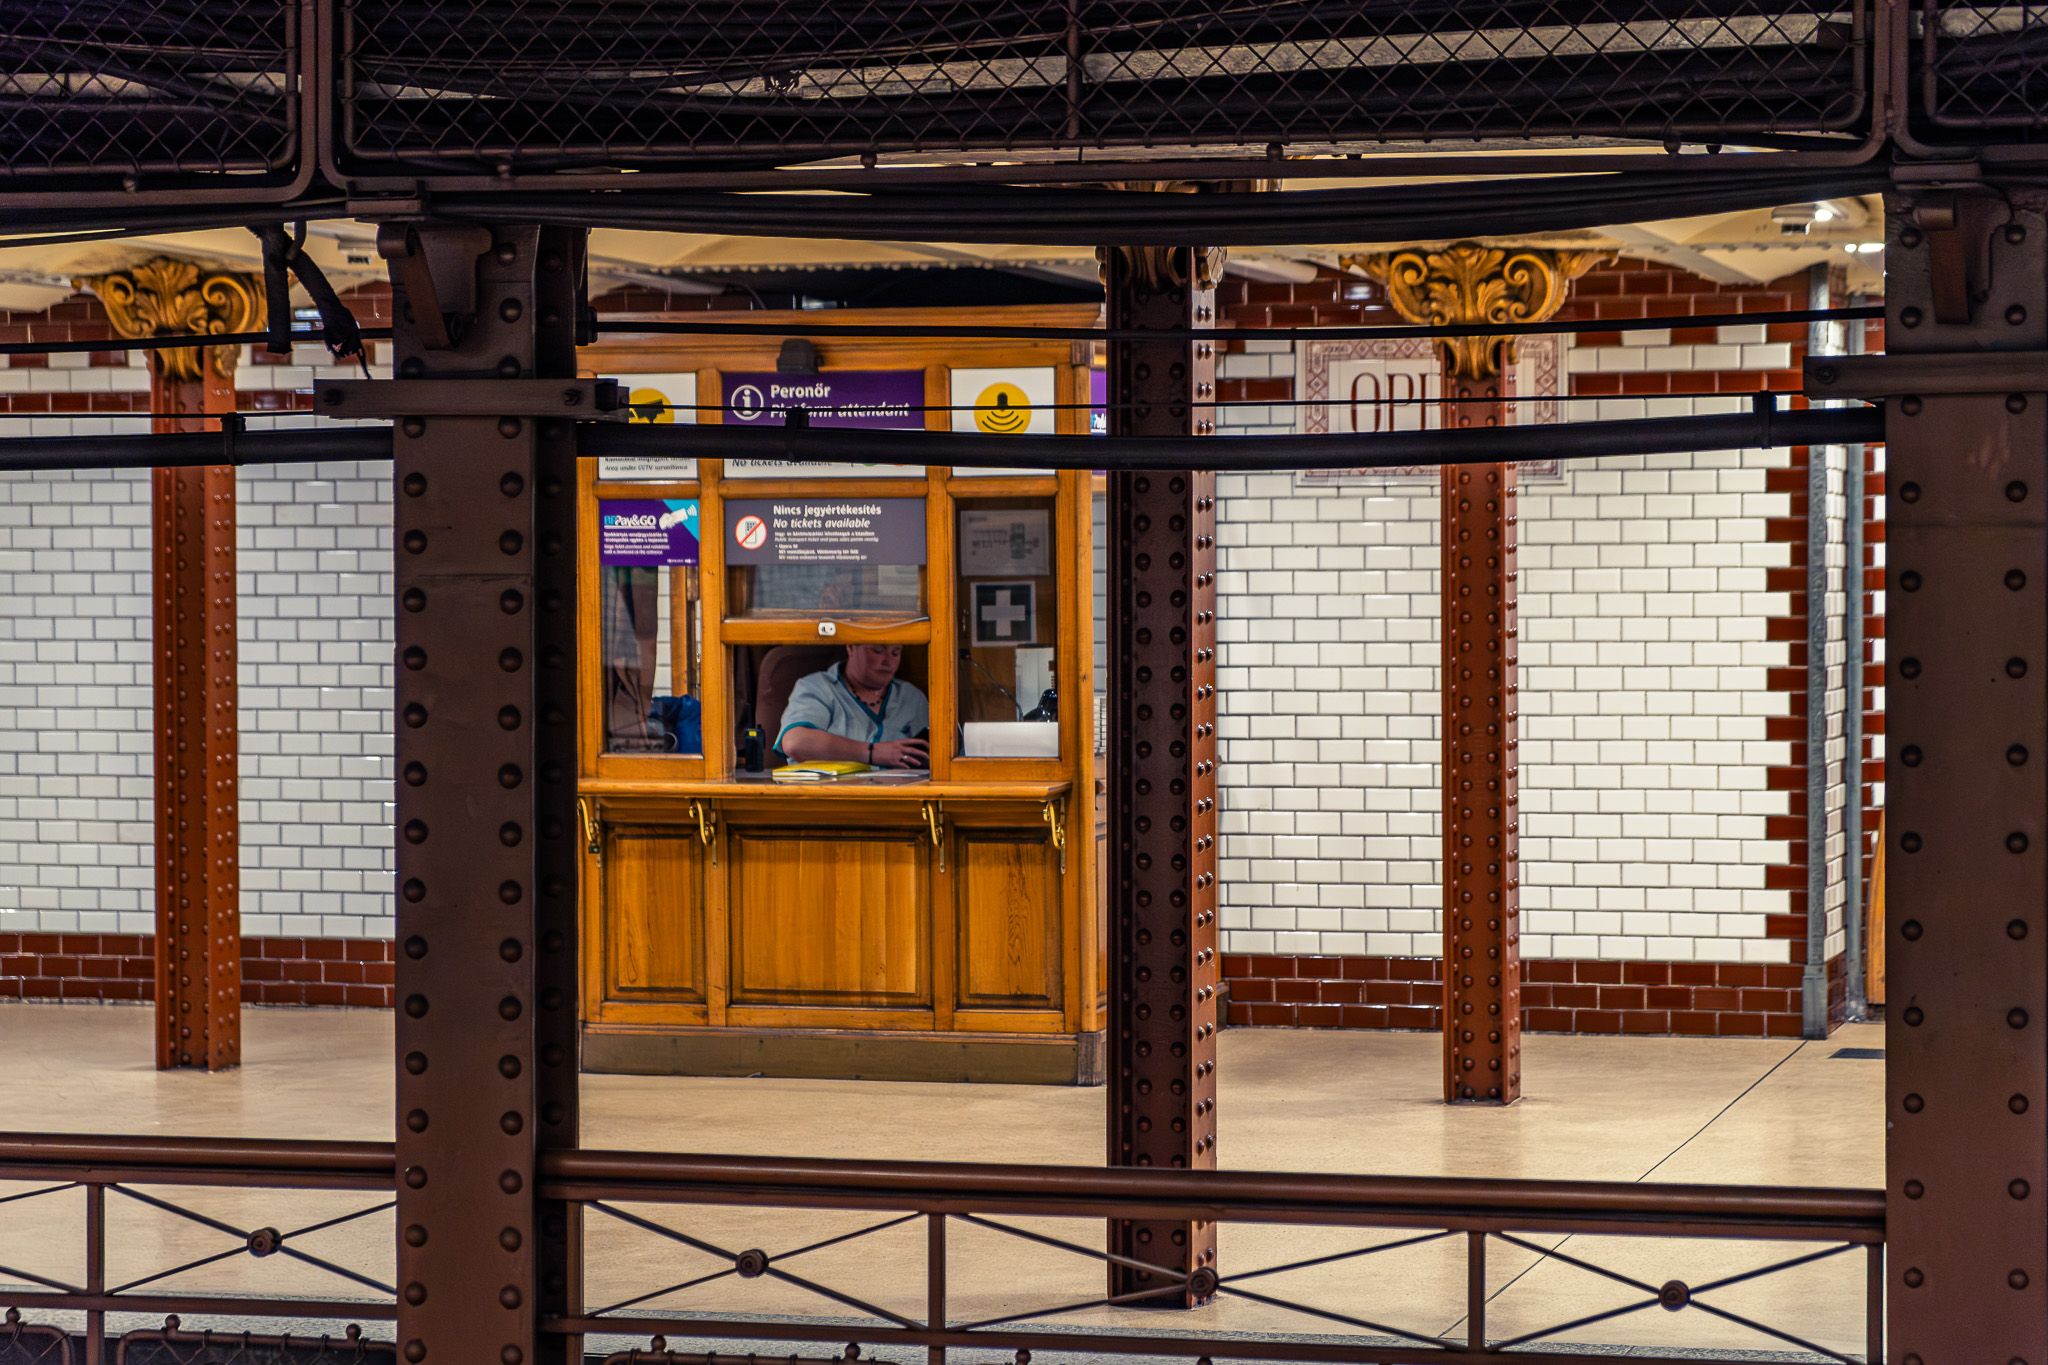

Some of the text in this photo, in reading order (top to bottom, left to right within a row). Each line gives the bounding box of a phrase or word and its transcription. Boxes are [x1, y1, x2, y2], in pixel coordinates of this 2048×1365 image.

[770, 382, 831, 399] Peronőr
[770, 402, 910, 418] Plform attendant
[731, 458, 746, 467] No
[773, 504, 882, 517] Nincs jegyértékesítés
[773, 518, 871, 528] No tickets available
